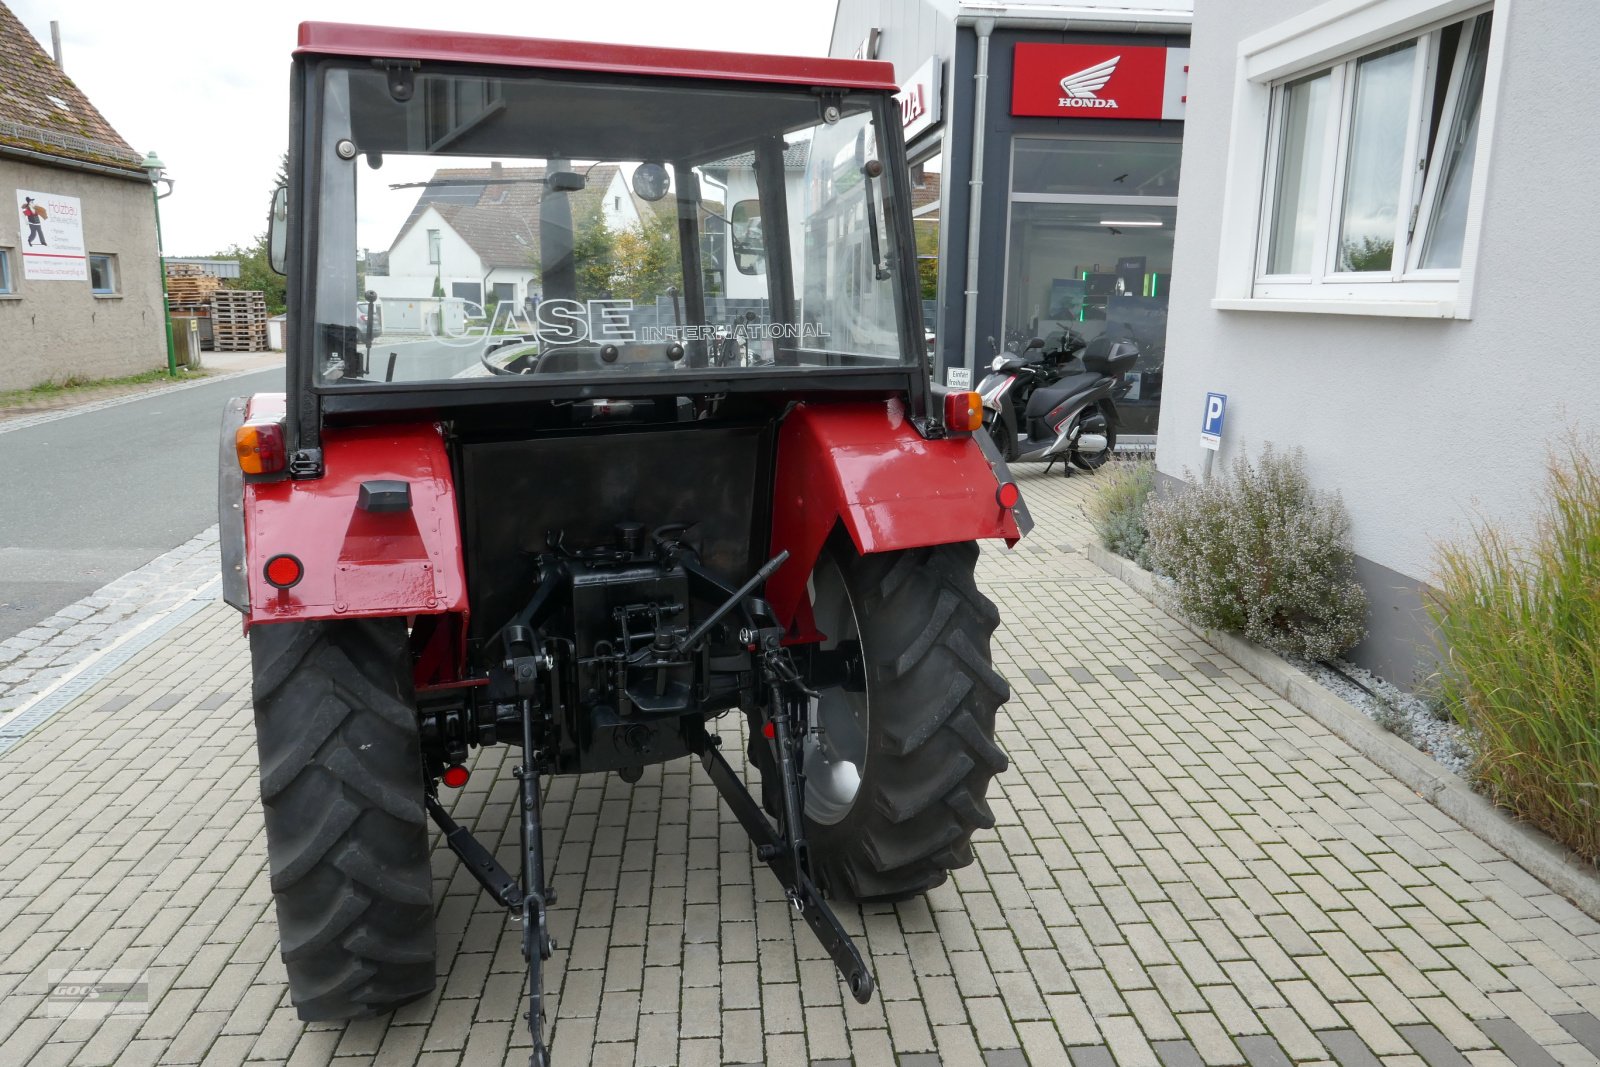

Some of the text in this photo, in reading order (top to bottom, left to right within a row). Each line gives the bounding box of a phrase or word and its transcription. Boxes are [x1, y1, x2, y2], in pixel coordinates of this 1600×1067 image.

[900, 83, 925, 128] DA
[1058, 97, 1119, 108] HONDA
[428, 298, 831, 348] CASE INTERNATIONAL
[1205, 396, 1223, 430] P
